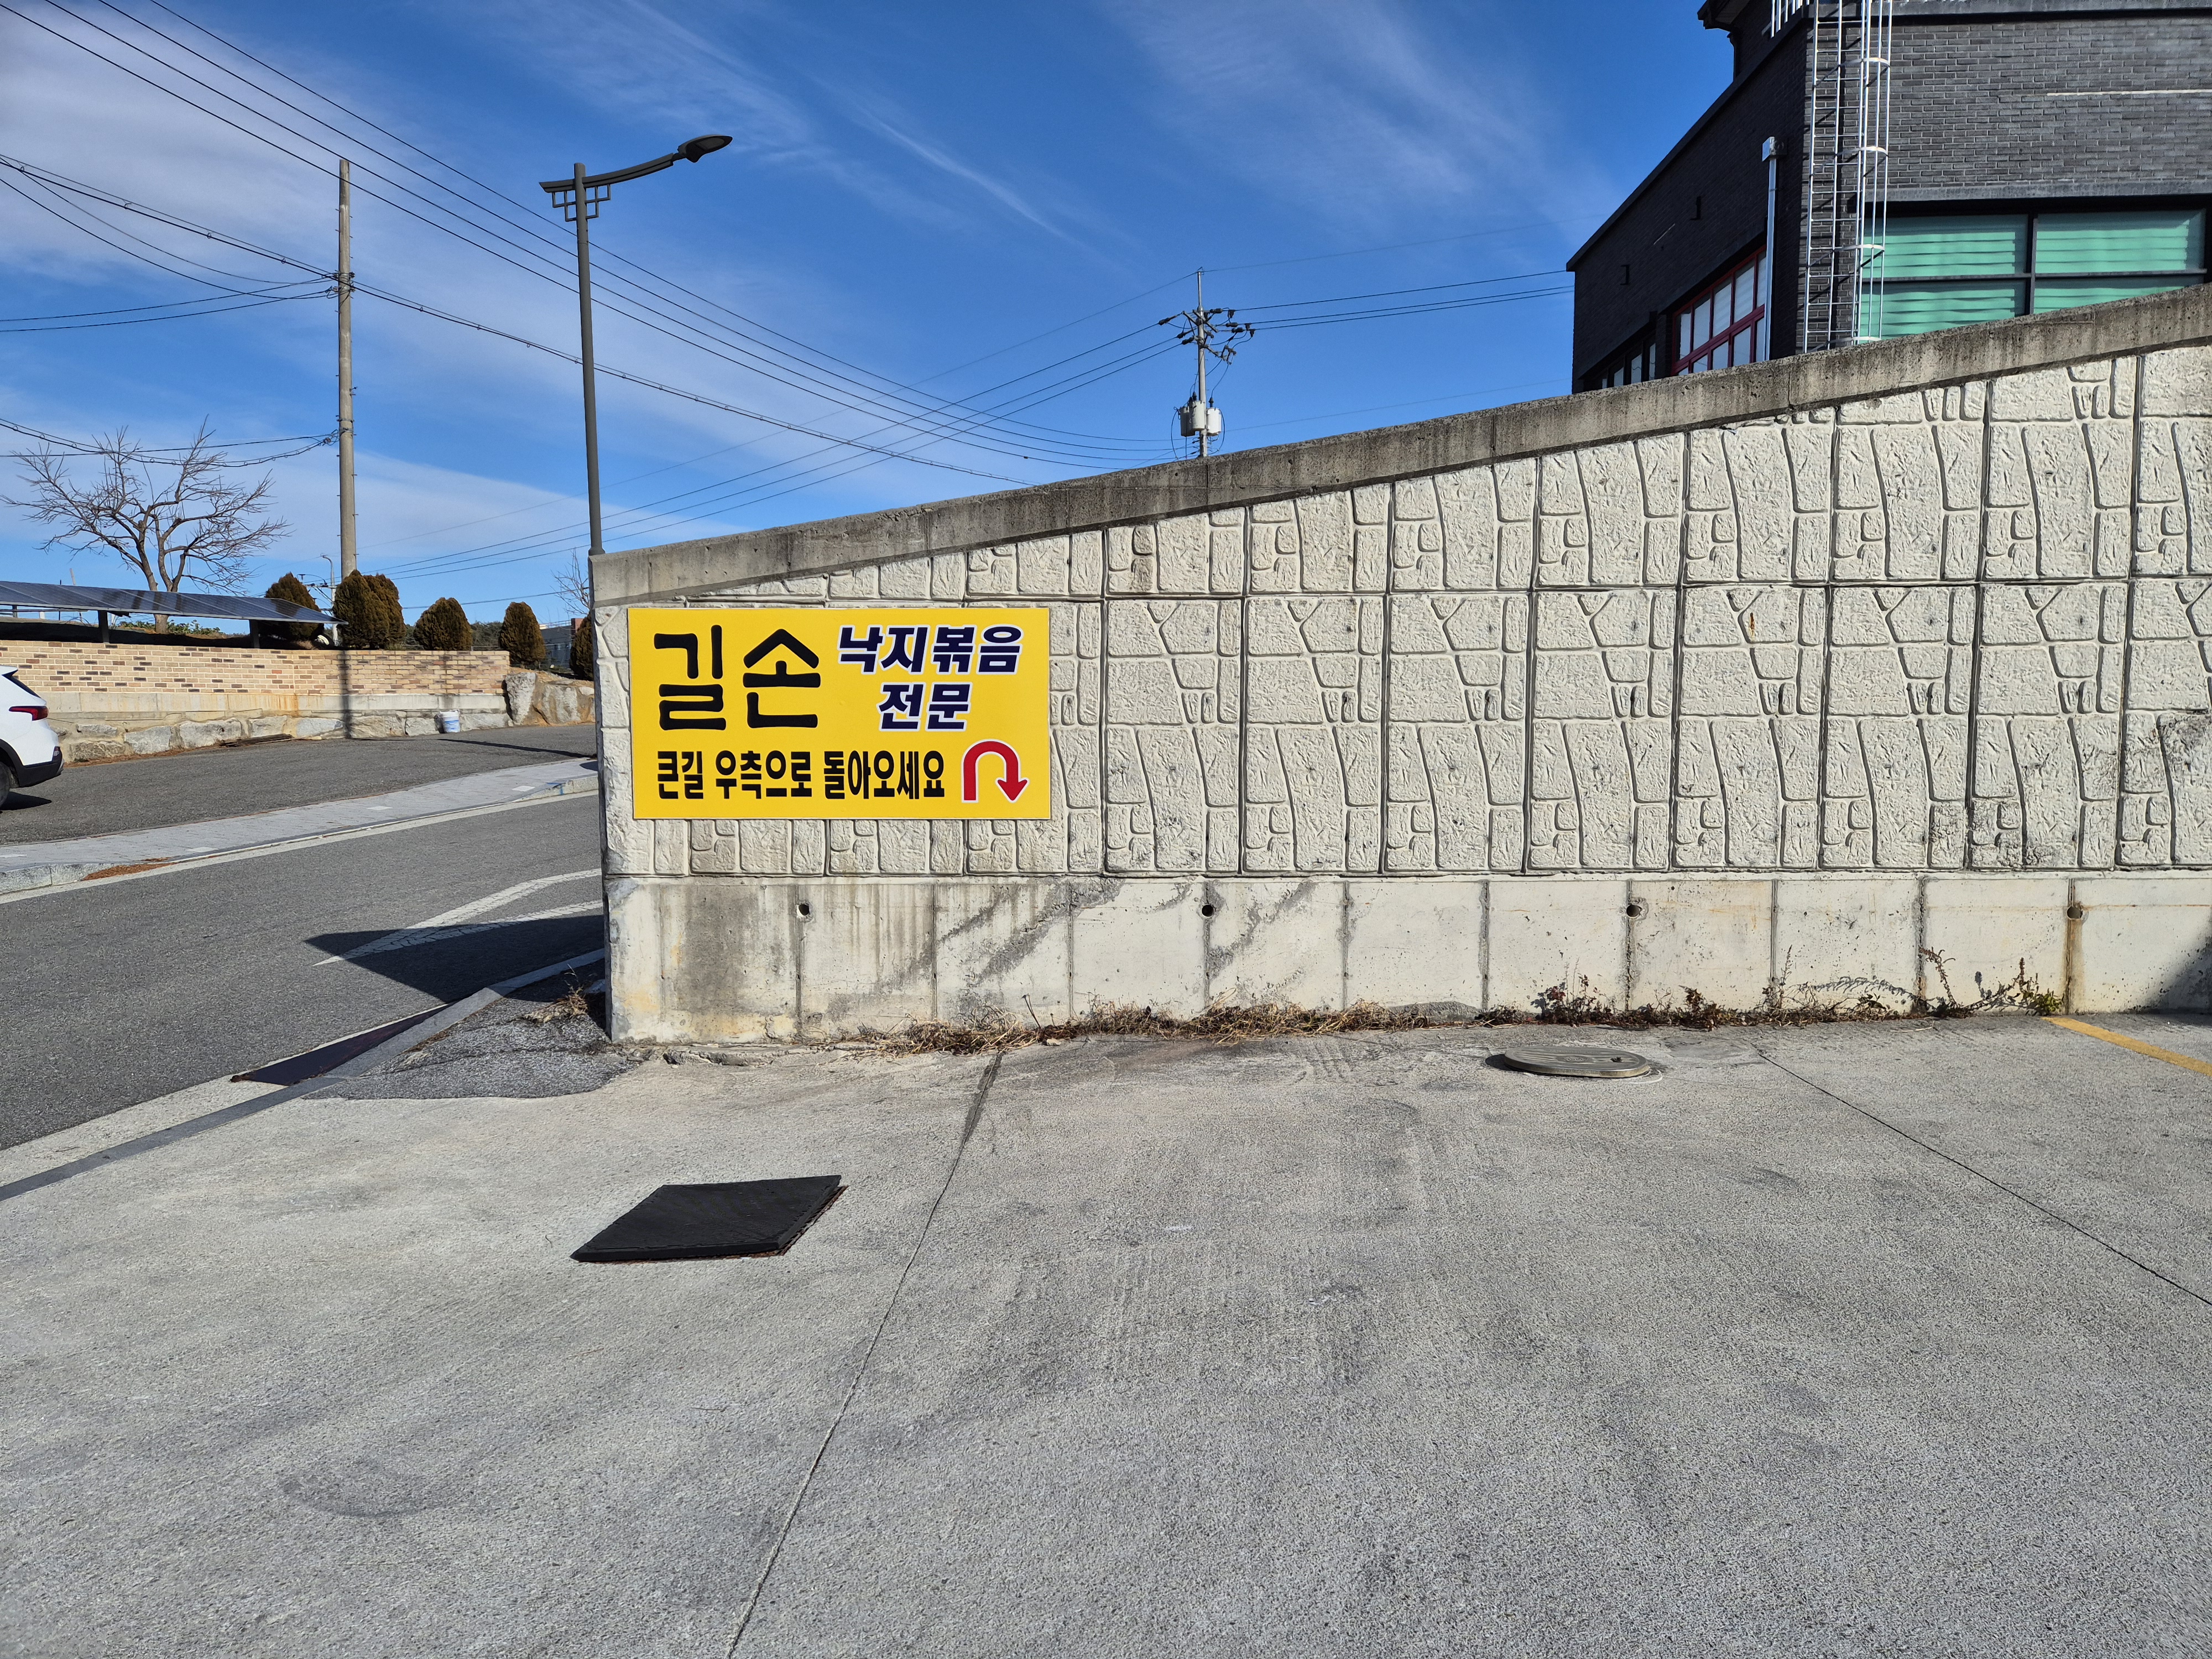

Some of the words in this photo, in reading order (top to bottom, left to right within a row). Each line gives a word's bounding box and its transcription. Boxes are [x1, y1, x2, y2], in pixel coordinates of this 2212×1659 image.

[839, 625, 1022, 673] 낙지볶음
[654, 624, 821, 731] 길손
[878, 684, 971, 730] 전문
[658, 751, 704, 800] 큰길
[716, 750, 812, 800] 우측으로
[823, 750, 945, 800] 돌아오세요
